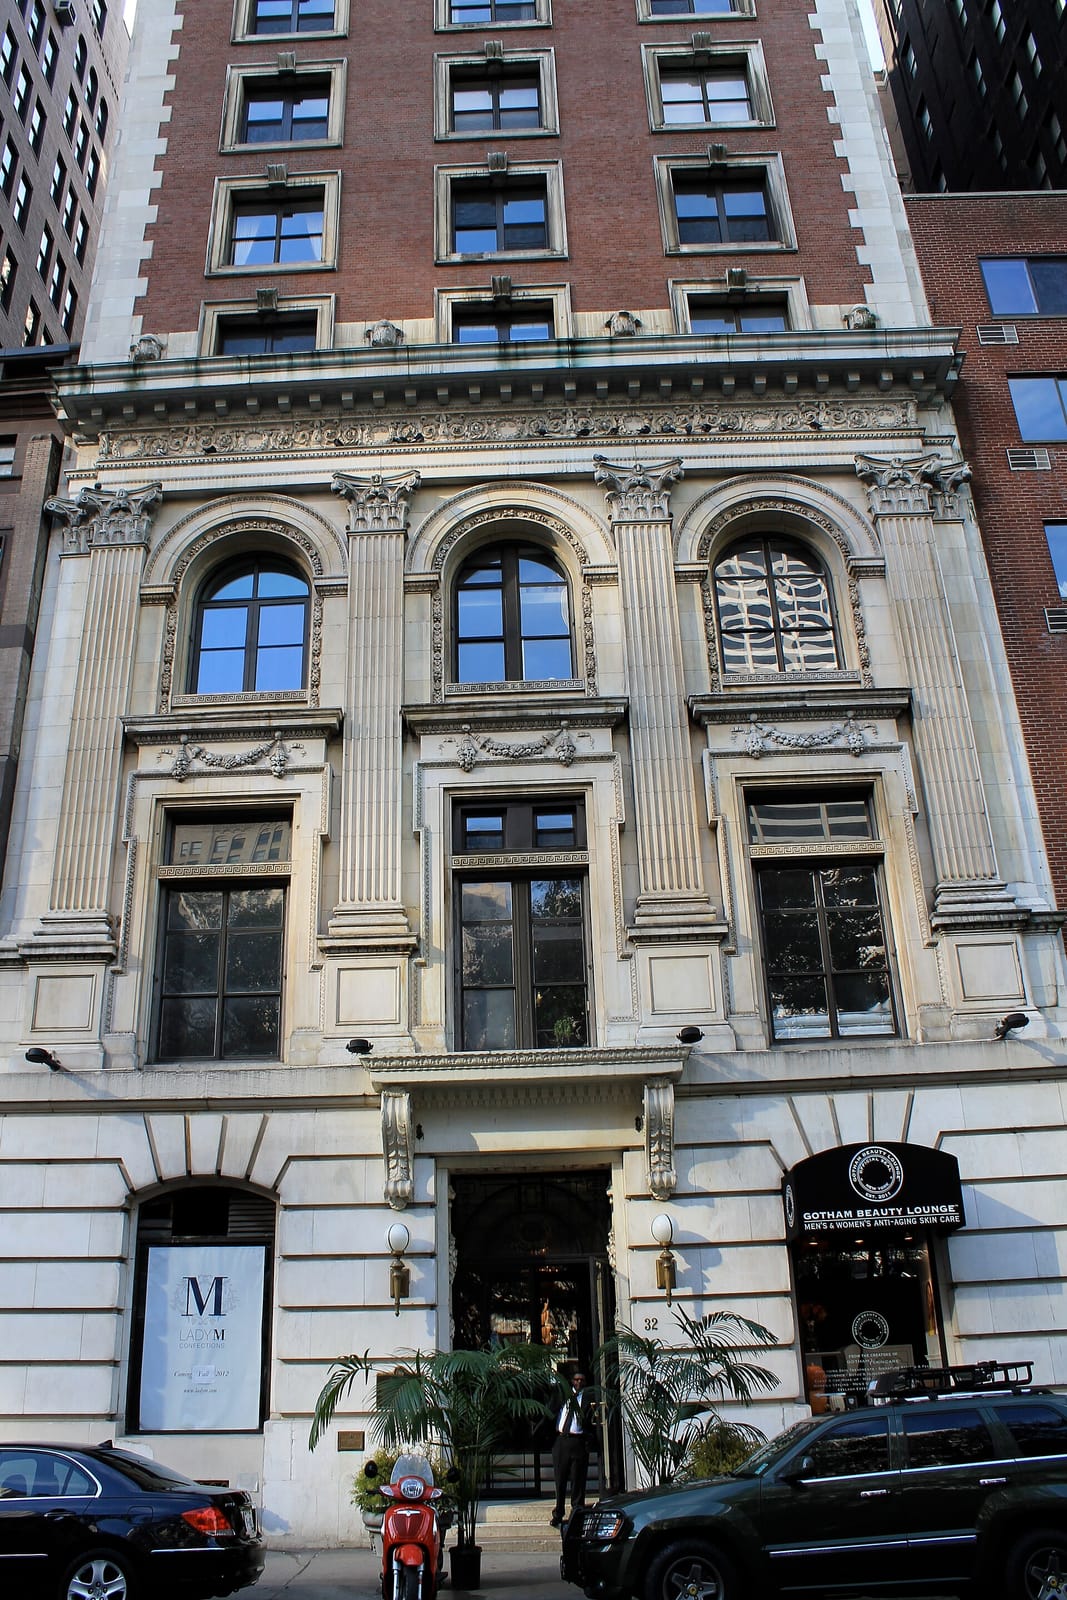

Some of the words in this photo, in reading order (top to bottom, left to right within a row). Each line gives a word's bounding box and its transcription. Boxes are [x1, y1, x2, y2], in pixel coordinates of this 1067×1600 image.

[861, 1149, 887, 1158] BEAUTY
[803, 1209, 853, 1220] GOTHAM
[856, 1207, 903, 1218] BEAUTY
[906, 1204, 956, 1215] LOUNGE
[804, 1222, 828, 1231] MEN'S
[836, 1219, 871, 1229] WOMEN'S
[874, 1217, 917, 1227] ANTI-AGING
[920, 1216, 938, 1224] SKIN
[940, 1215, 960, 1223] CARE
[181, 1276, 229, 1317] M
[644, 1317, 659, 1331] 32
[215, 1369, 230, 1378] 2012
